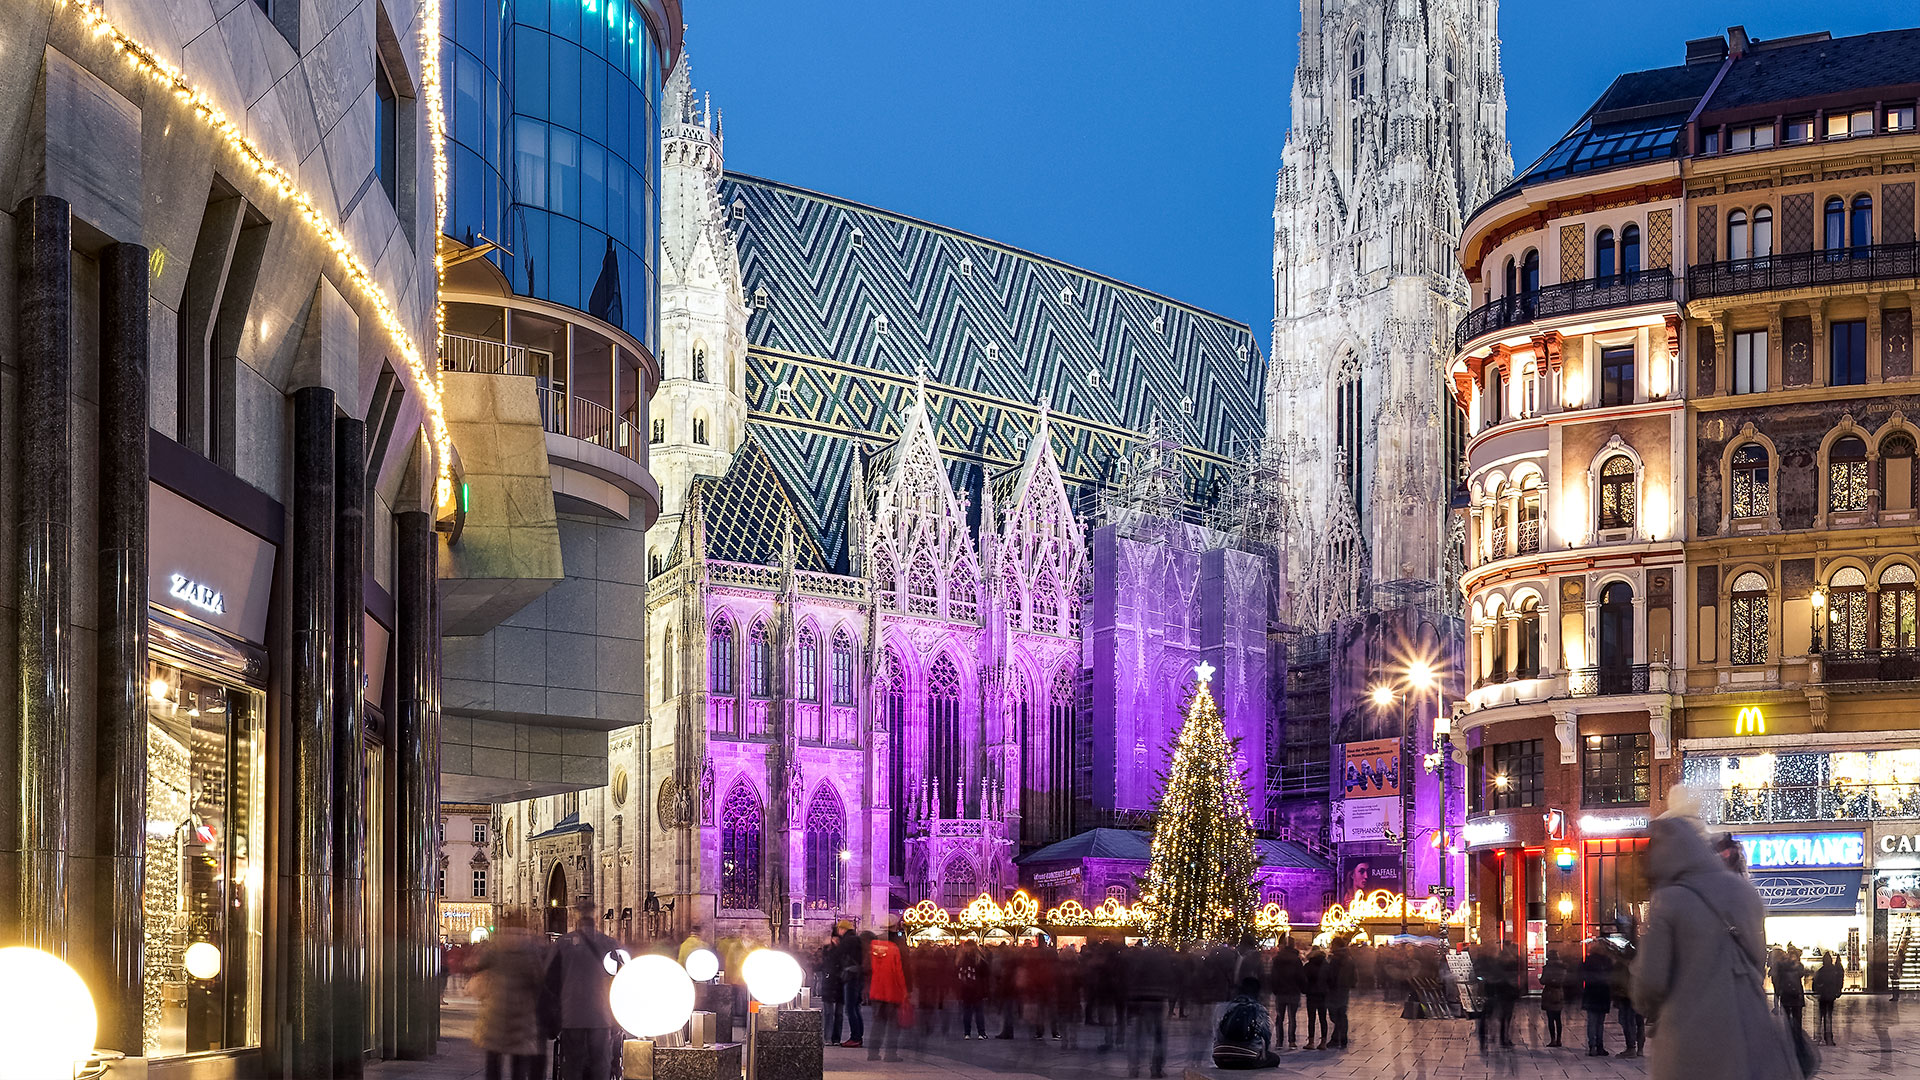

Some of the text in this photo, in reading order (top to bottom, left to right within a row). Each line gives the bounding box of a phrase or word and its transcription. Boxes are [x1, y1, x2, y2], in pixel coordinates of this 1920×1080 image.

[170, 573, 227, 614] ZARA
[1760, 838, 1863, 866] EXCHANGE
[1371, 868, 1397, 876] RAFFAEL
[1796, 885, 1847, 896] GROUP
